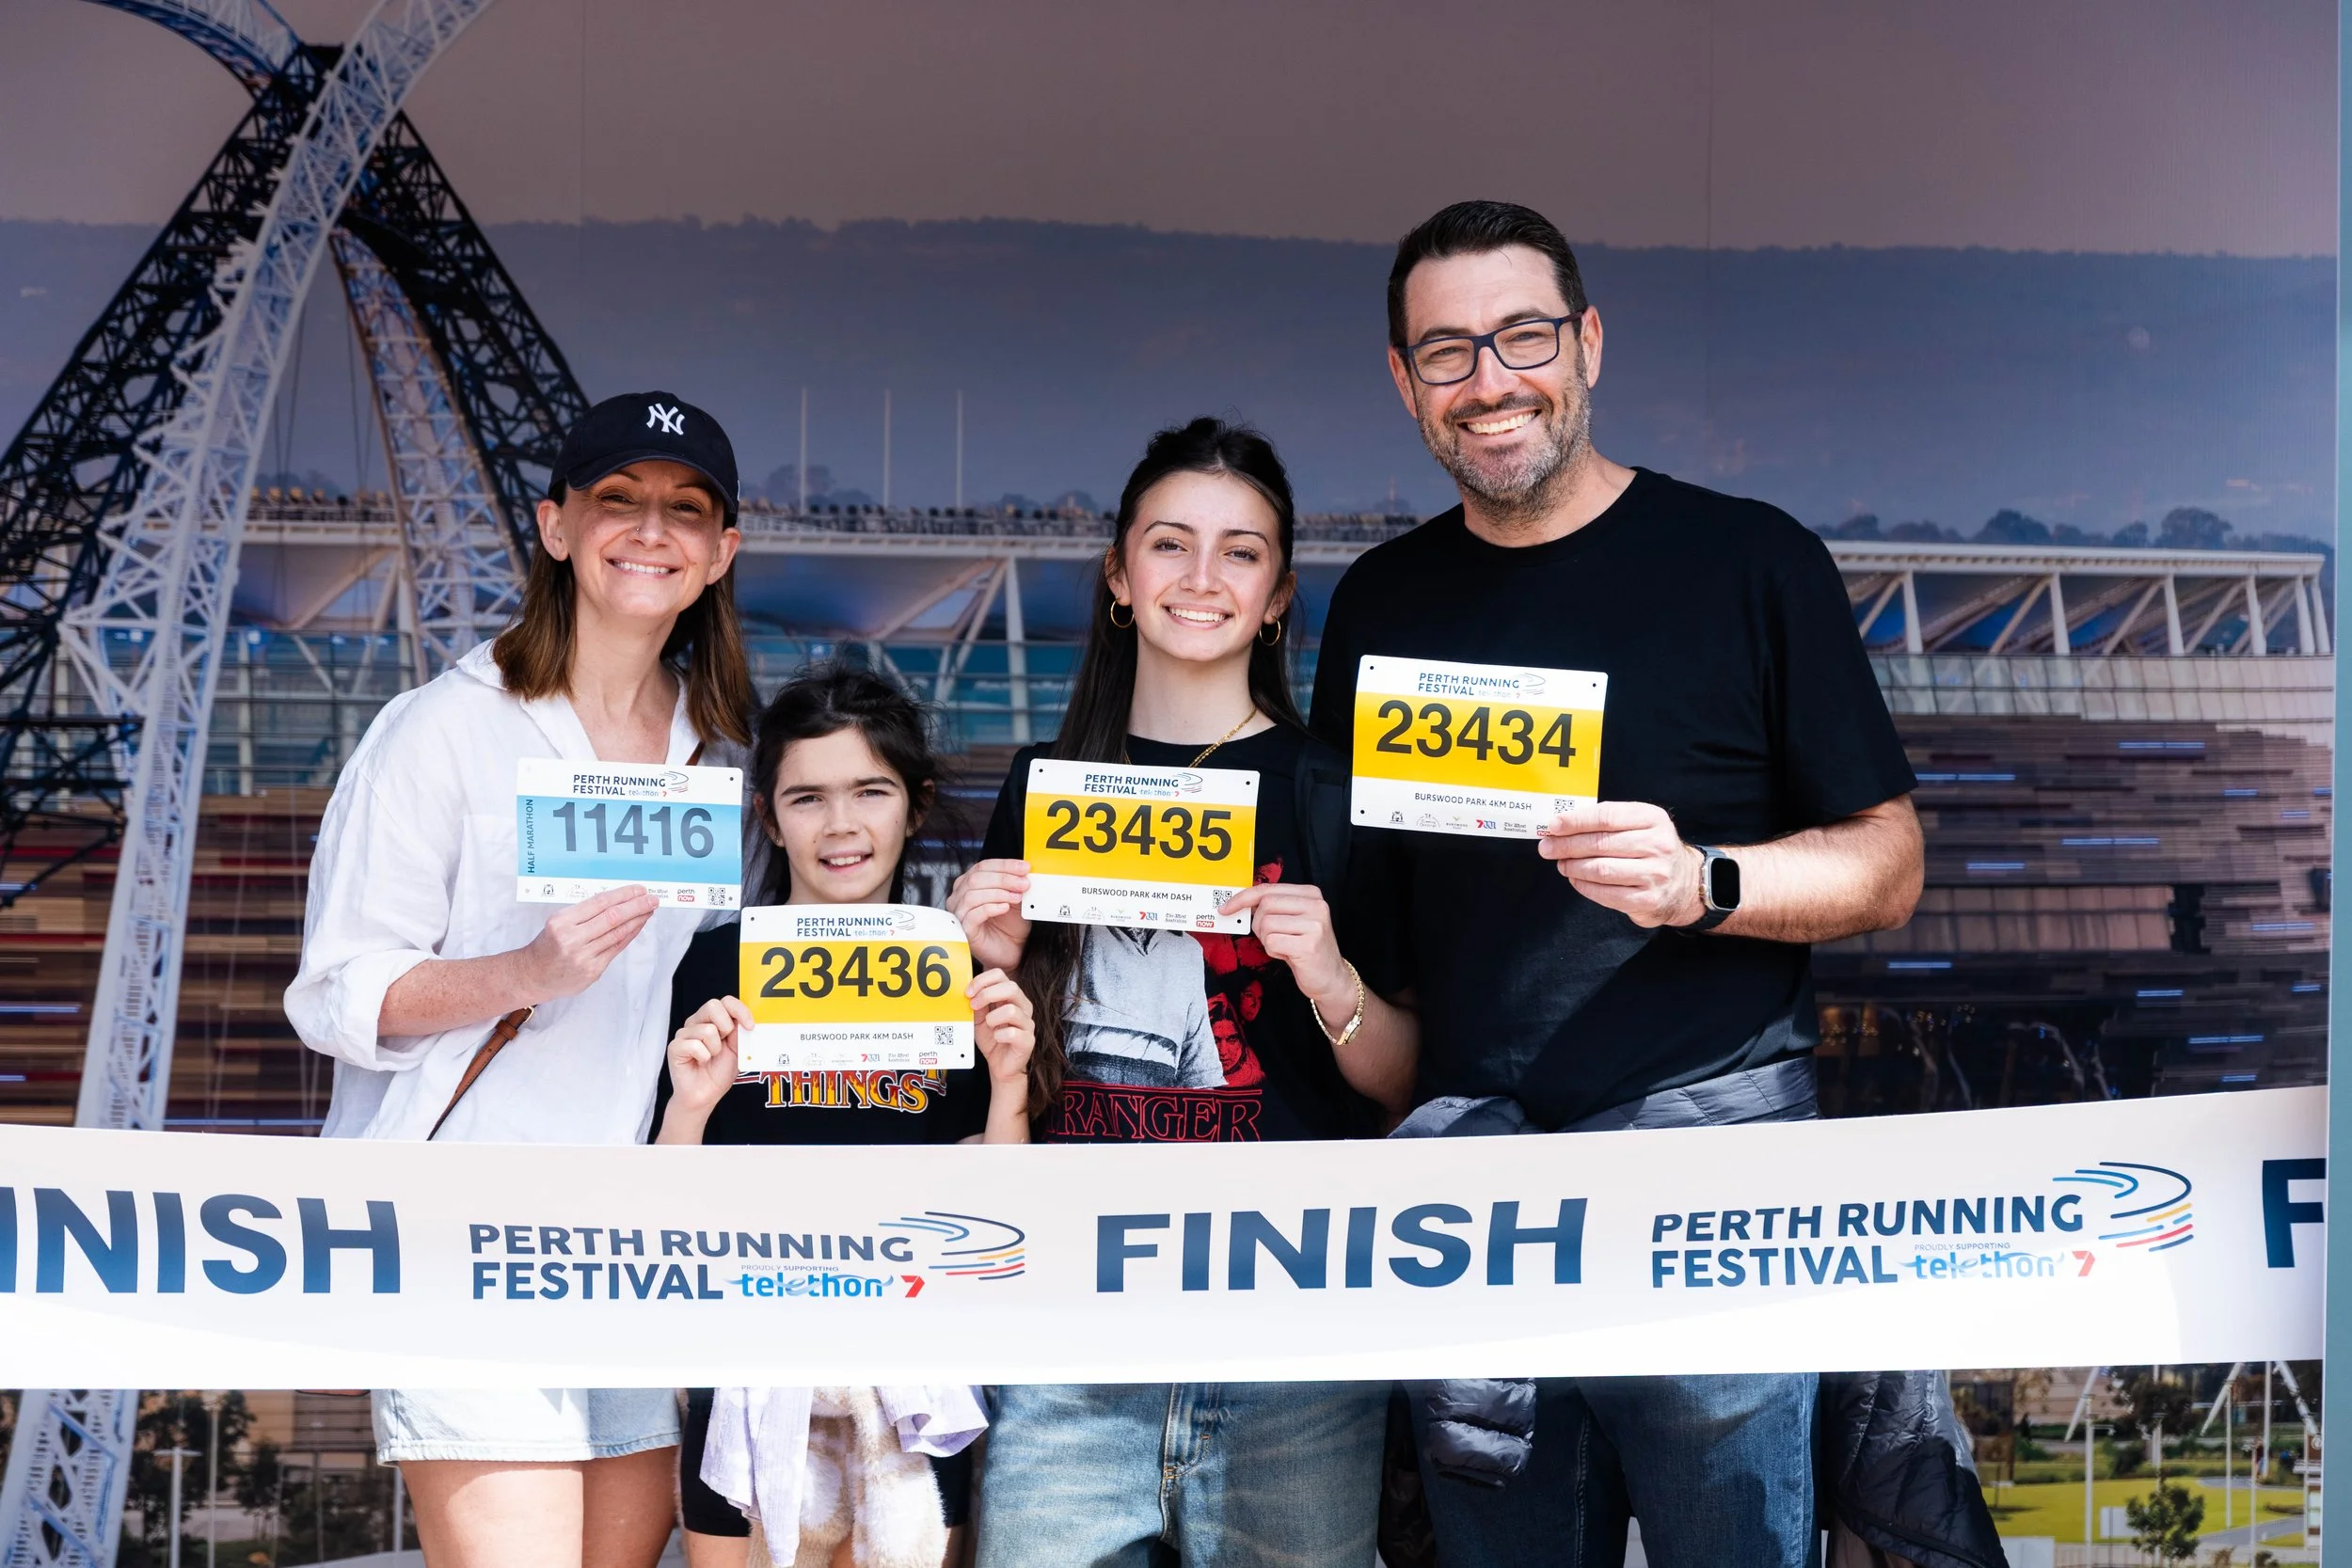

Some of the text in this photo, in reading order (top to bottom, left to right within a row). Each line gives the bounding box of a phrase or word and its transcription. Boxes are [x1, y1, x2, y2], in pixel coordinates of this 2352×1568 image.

[645, 403, 685, 435] NY
[1419, 673, 1519, 689] PERTH RUNNING
[1419, 683, 1474, 696] FESTIVAL
[1479, 689, 1511, 698] telthon
[1376, 700, 1576, 768] 23434
[572, 784, 626, 796] FESTIVAL
[573, 774, 666, 787] PERTH RUNNING
[1084, 784, 1136, 795] FESTIVAL
[1140, 788, 1171, 797] telthon
[1085, 774, 1179, 787] PERTH RUNNING
[1415, 792, 1532, 811] BURSWOOD PARK 4KM DASH
[525, 799, 535, 874] HALF MARATHON
[553, 801, 714, 858] 11416
[1046, 800, 1232, 861] 23435
[1082, 887, 1128, 897] BURSWOOD
[1129, 890, 1150, 898] PARK
[797, 917, 893, 927] PERTH RUNNING
[797, 927, 850, 937] FESTIVAL
[854, 928, 886, 937] telthon
[760, 946, 952, 999] 23436
[760, 1070, 929, 1114] THINGS
[1057, 1089, 1262, 1142] RANGER
[1651, 1195, 2083, 1243] PERTH RUNNING
[469, 1223, 914, 1262] PERTH RUNNING
[1097, 1198, 1588, 1292] FINISH
[1956, 1242, 2011, 1250] SUPPORTING
[473, 1262, 723, 1300] FESTIVAL
[741, 1272, 883, 1298] telethon
[1652, 1244, 1899, 1289] FESTIVAL
[1915, 1251, 2055, 1279] telethon
